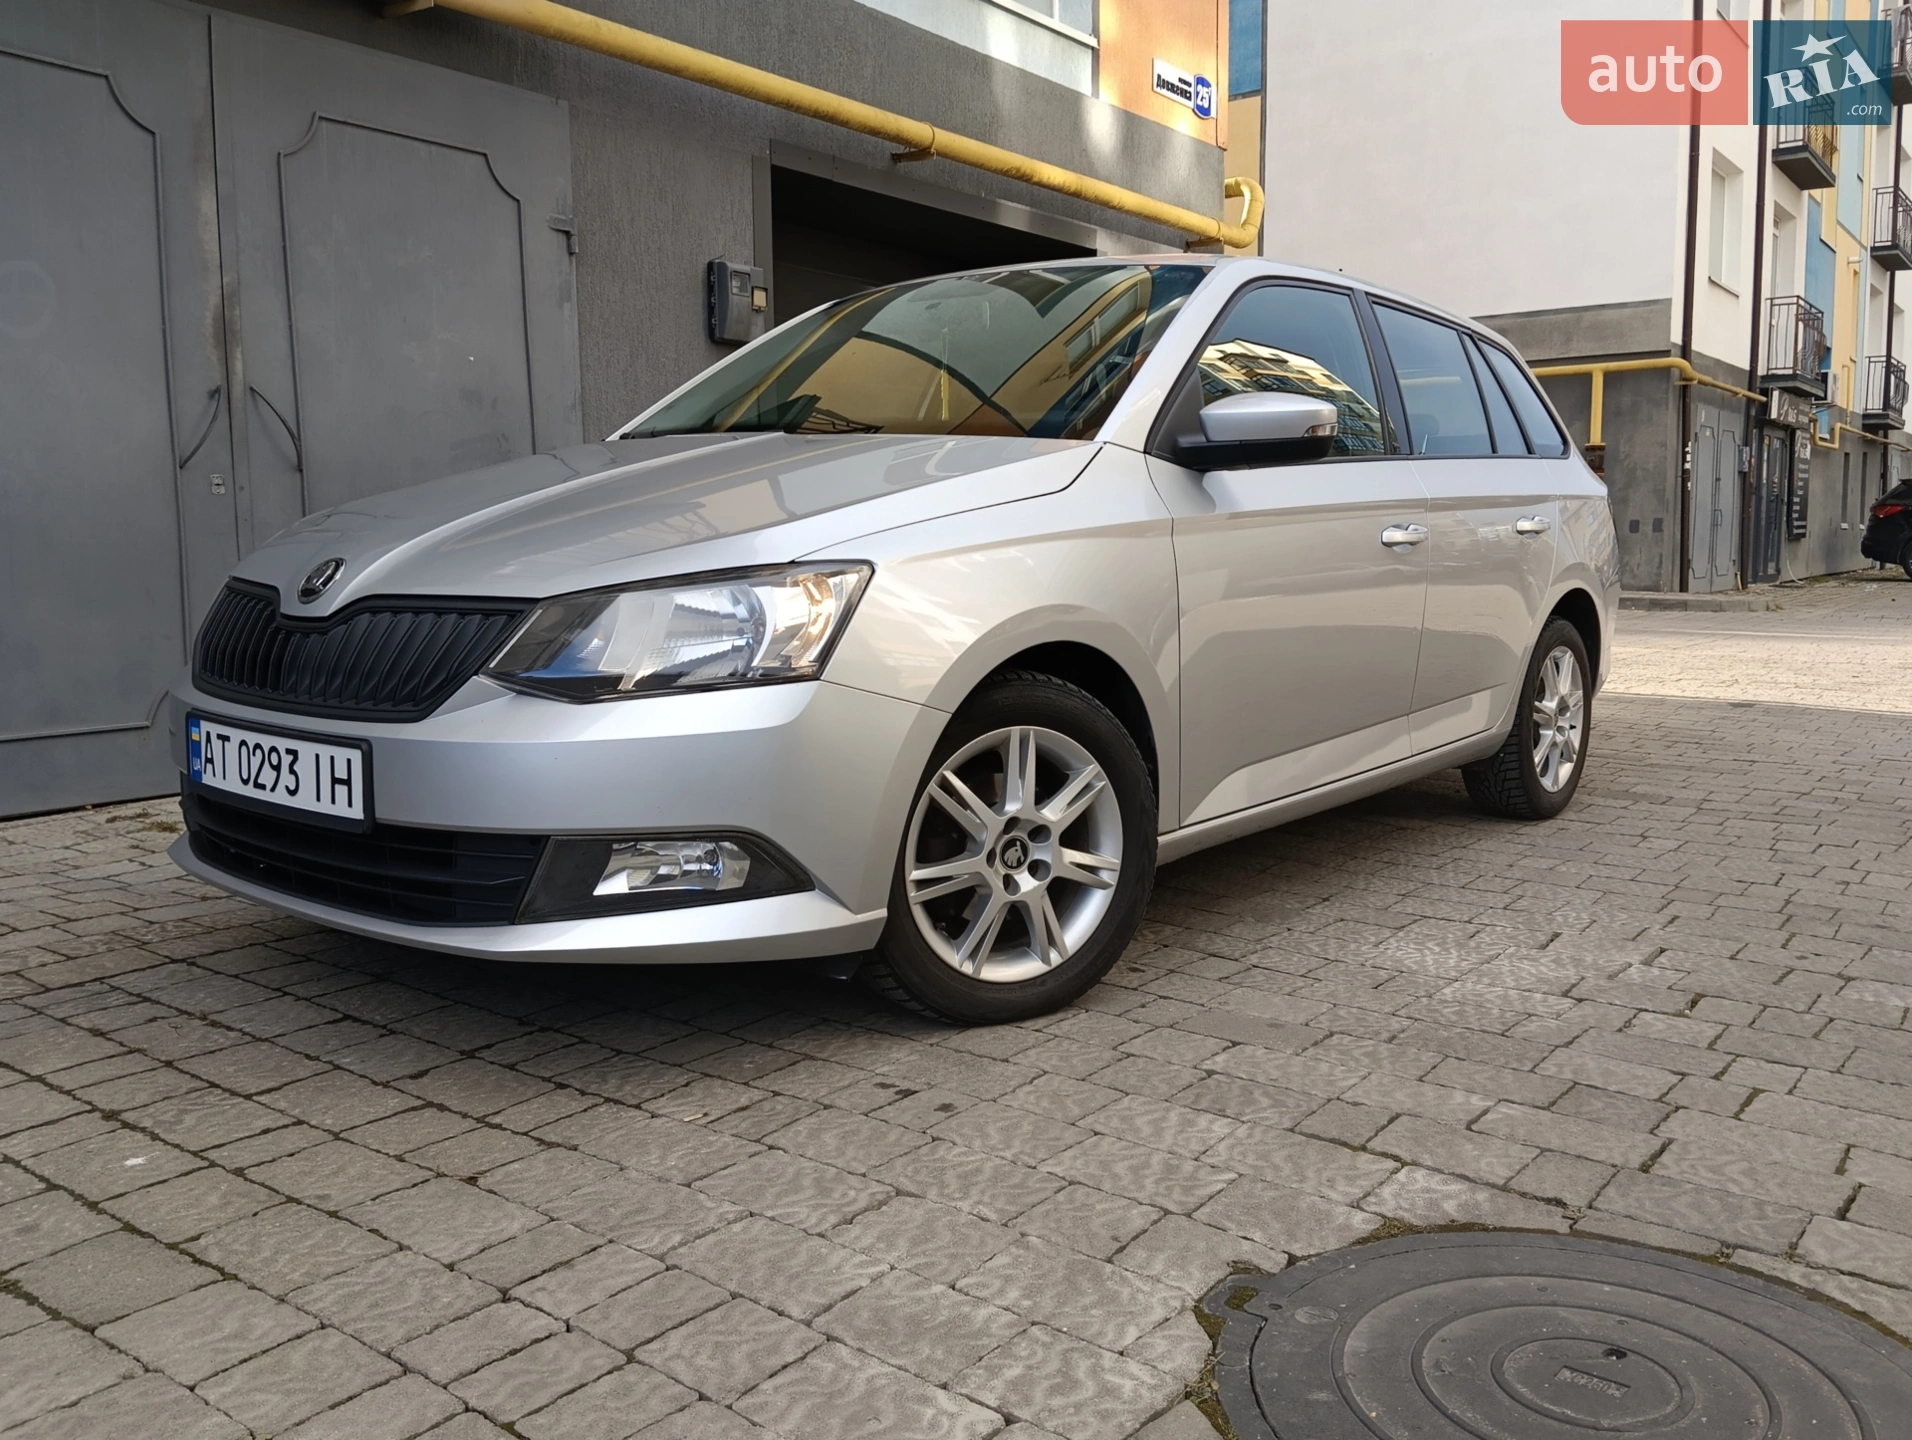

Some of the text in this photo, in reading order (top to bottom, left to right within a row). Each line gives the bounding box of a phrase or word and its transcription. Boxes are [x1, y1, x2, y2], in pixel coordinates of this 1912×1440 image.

[193, 757, 202, 771] UA
[204, 730, 353, 808] AT 0293 IH
